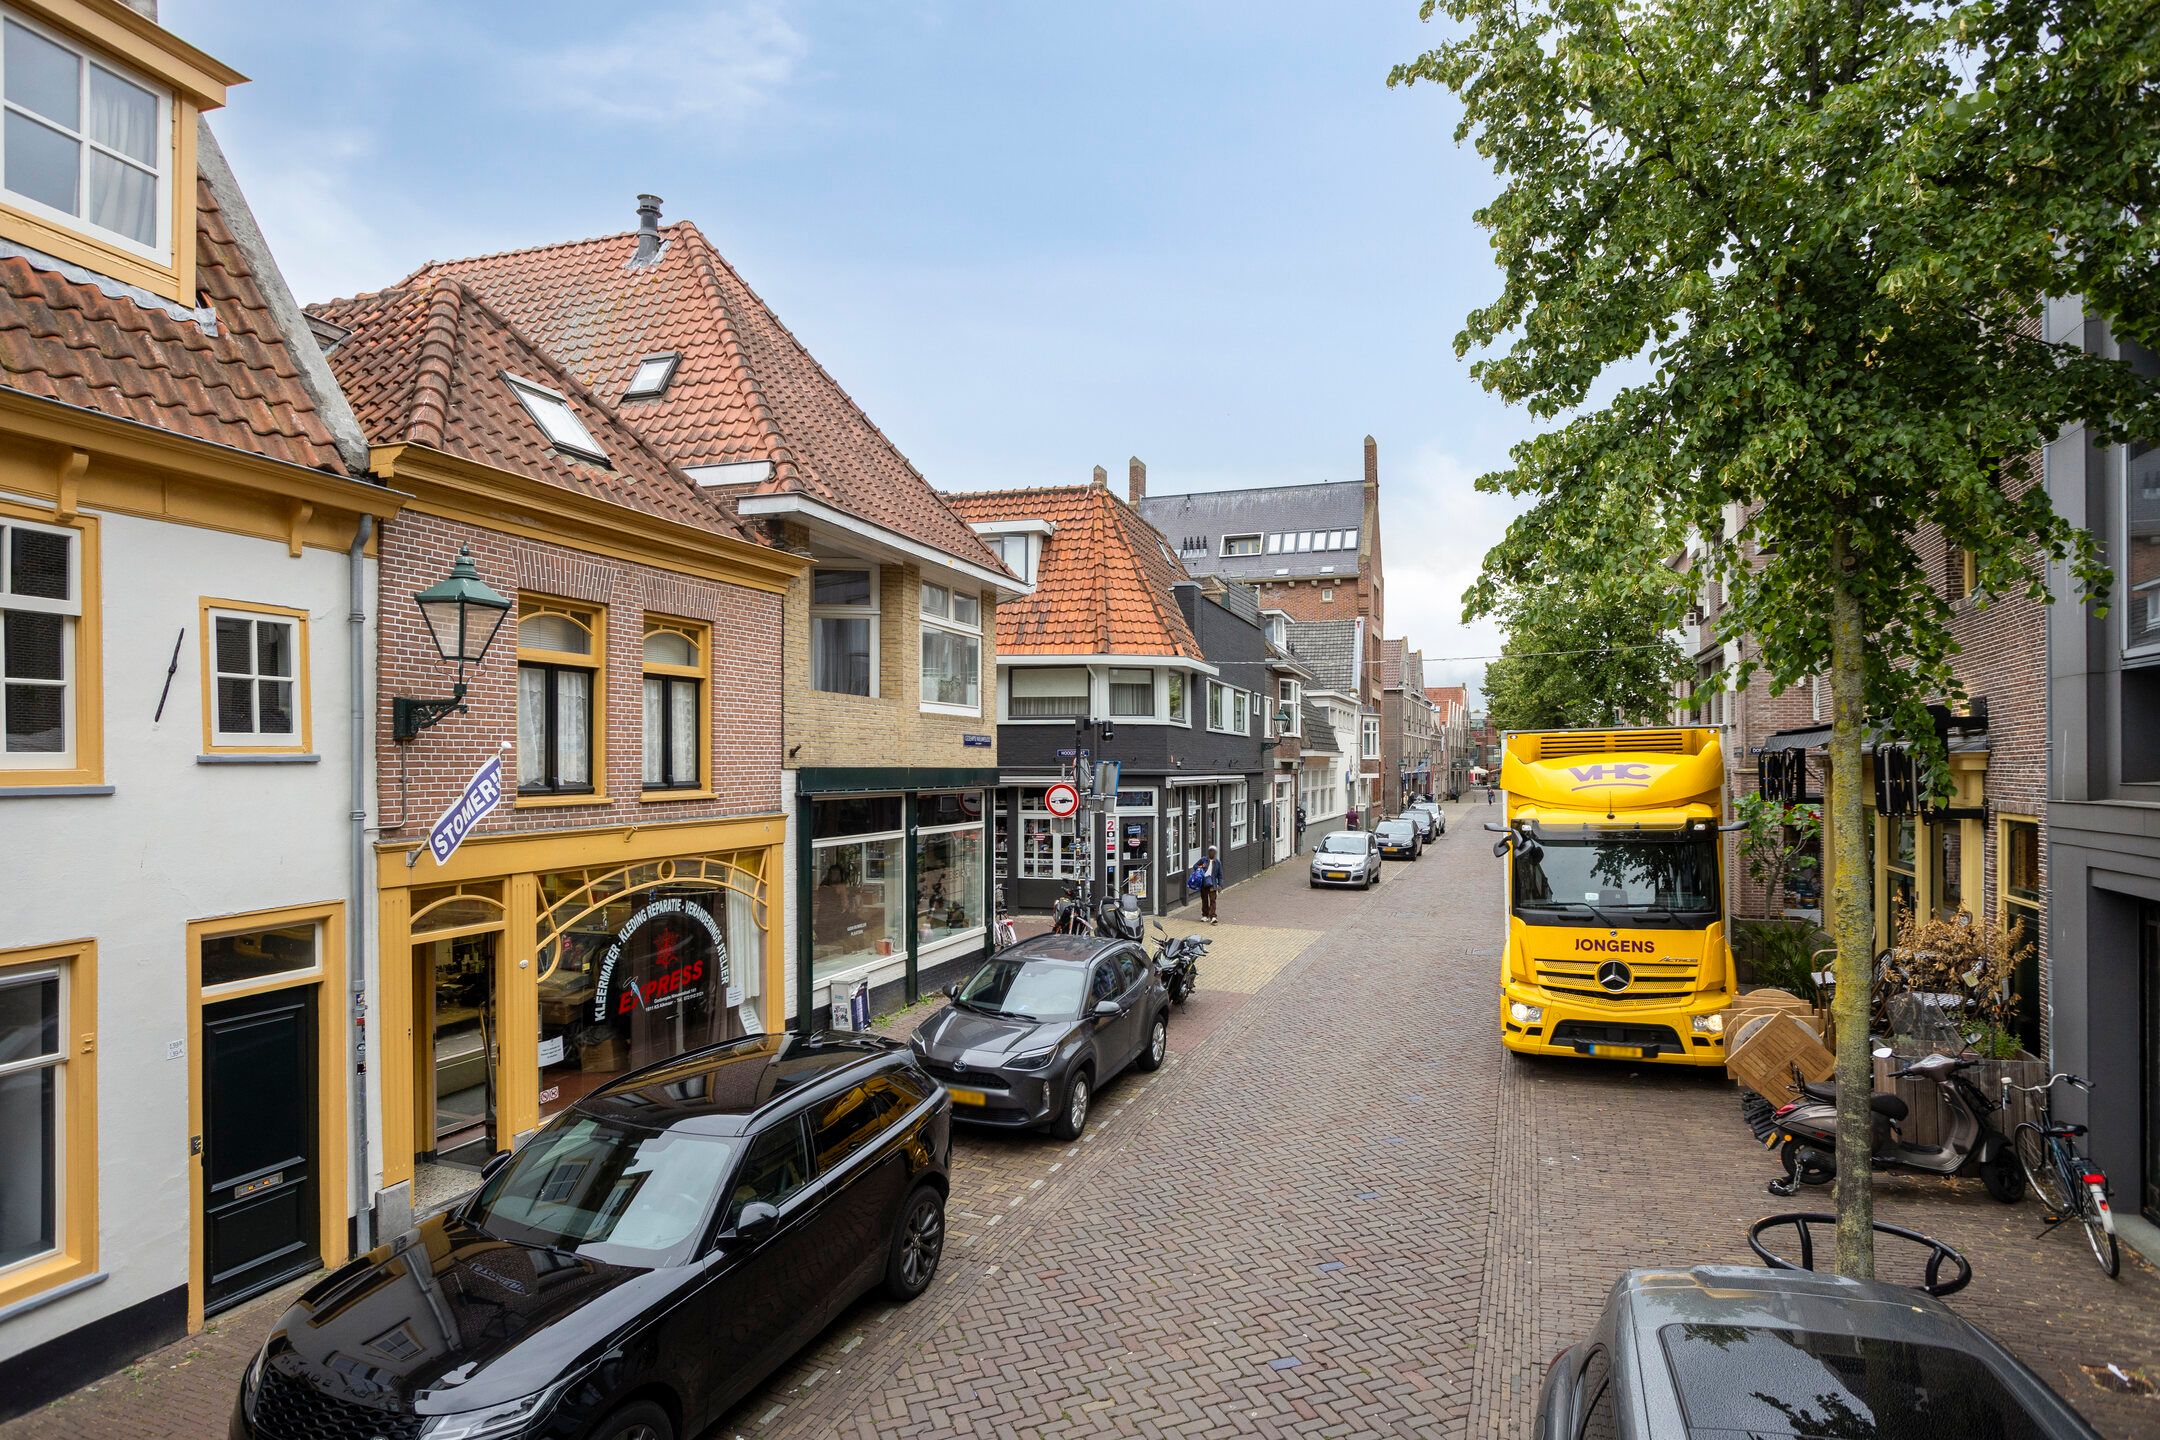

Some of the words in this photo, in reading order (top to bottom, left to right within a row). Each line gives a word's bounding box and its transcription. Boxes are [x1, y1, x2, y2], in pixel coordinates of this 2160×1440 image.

[1568, 763, 1652, 782] VHC
[1106, 820, 1114, 831] 2
[1575, 938, 1655, 953] JONGENS
[594, 943, 621, 1022] KLEERMAKER
[617, 909, 647, 943] KLEDING
[646, 898, 682, 920] REPARATIE
[684, 900, 723, 945] VERANDERINGS
[716, 942, 730, 986] ATELIER
[618, 959, 705, 1017] EXPRESS
